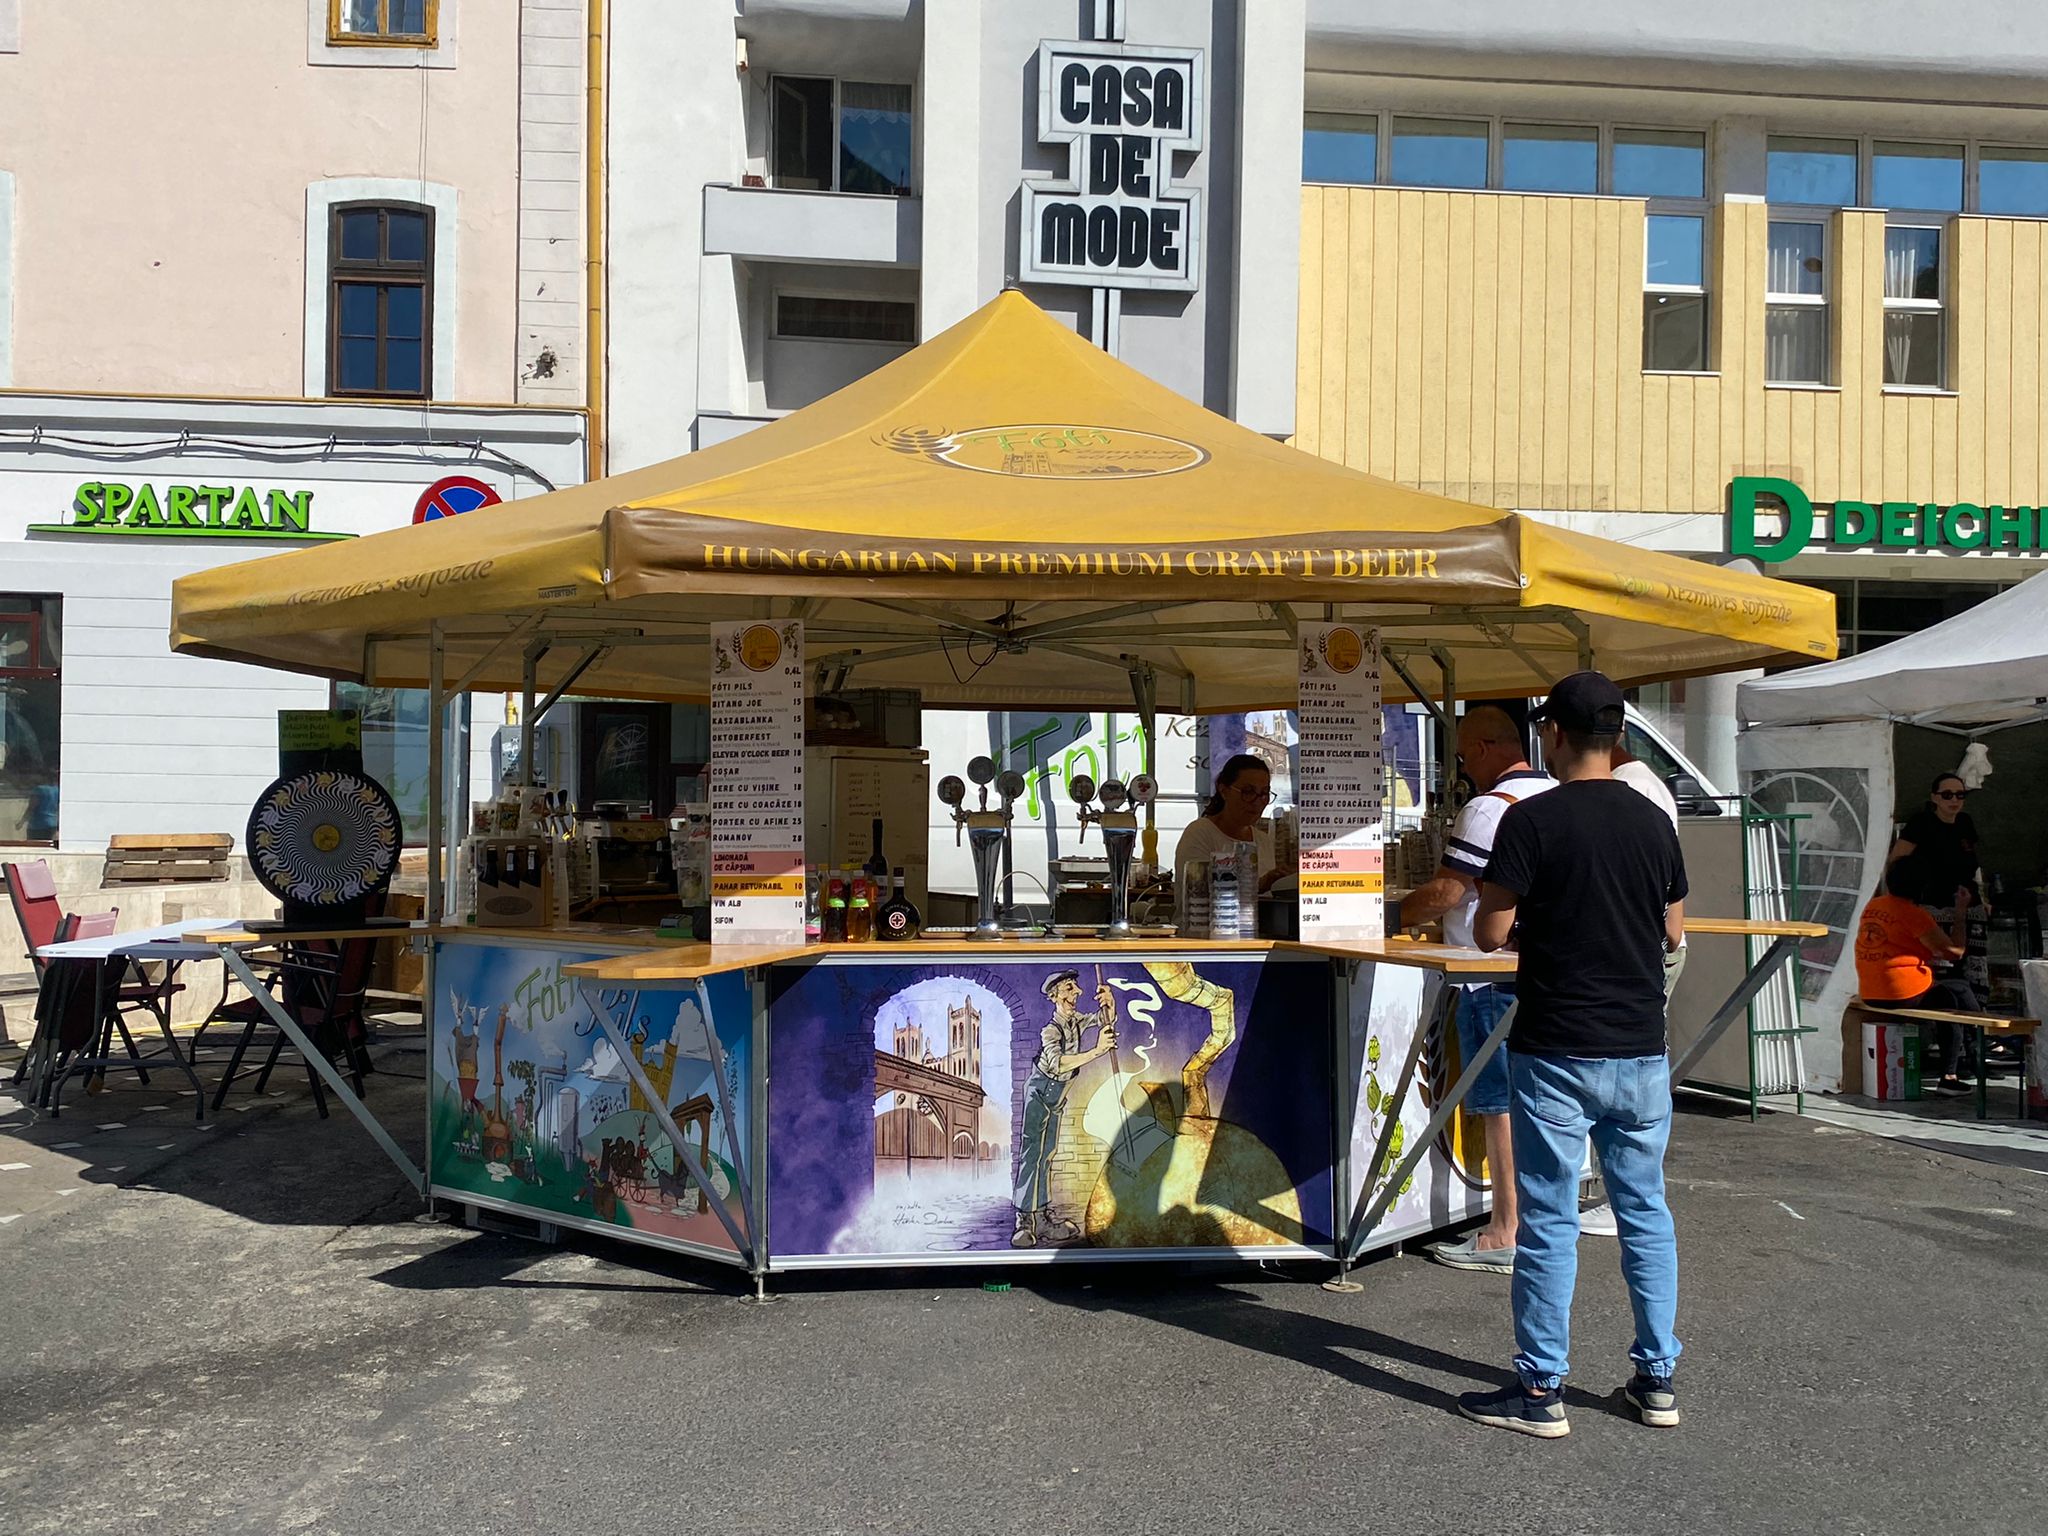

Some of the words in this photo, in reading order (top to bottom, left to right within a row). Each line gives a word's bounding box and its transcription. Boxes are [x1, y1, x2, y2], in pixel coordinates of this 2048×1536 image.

[1060, 63, 1183, 130] CASA
[1090, 134, 1151, 198] DE
[1040, 202, 1181, 270] MODE
[74, 482, 313, 532] SPARTAN
[1731, 476, 1814, 562] D
[1834, 500, 2048, 550] DEICH
[702, 543, 958, 573] HUNGARIAN
[971, 551, 1173, 577] PREMIUM
[1185, 549, 1323, 577] CRAFT
[1331, 548, 1440, 579] BEER
[712, 682, 731, 692] FÓTI
[734, 682, 752, 690] PILS
[794, 681, 801, 689] 12
[1300, 681, 1317, 690] FÓTI
[794, 698, 801, 706] 15
[1332, 700, 1345, 708] JOE
[712, 716, 773, 725] KASZABLANKA
[794, 715, 801, 723] 15
[1300, 716, 1355, 725] KASZABLANKA
[1372, 718, 1380, 726] 15
[712, 733, 770, 741] OKTOBERFEST
[1300, 732, 1353, 741] OKTOBERFEST
[712, 750, 738, 758] ELEVEN
[741, 750, 770, 758] O'CLOCK
[1326, 750, 1352, 758] O'CLOCK
[712, 784, 734, 792] BERE
[738, 784, 748, 792] CU
[1301, 800, 1320, 808] BERE
[1324, 800, 1334, 808] CU
[712, 818, 744, 826] PORTER
[749, 818, 760, 826] CU
[1301, 816, 1330, 824] PORTER
[1334, 816, 1344, 824] CU
[712, 834, 752, 842] ROMANOV
[1301, 832, 1337, 840] ROMANOV
[794, 858, 802, 866] 10
[1374, 856, 1381, 864] 10
[714, 882, 738, 890] PAHAR
[740, 882, 783, 890] RETURNABIL
[794, 882, 802, 890] 10
[1302, 880, 1324, 888] PAHAR
[714, 900, 726, 908] VIN
[1302, 914, 1320, 922] SIFON
